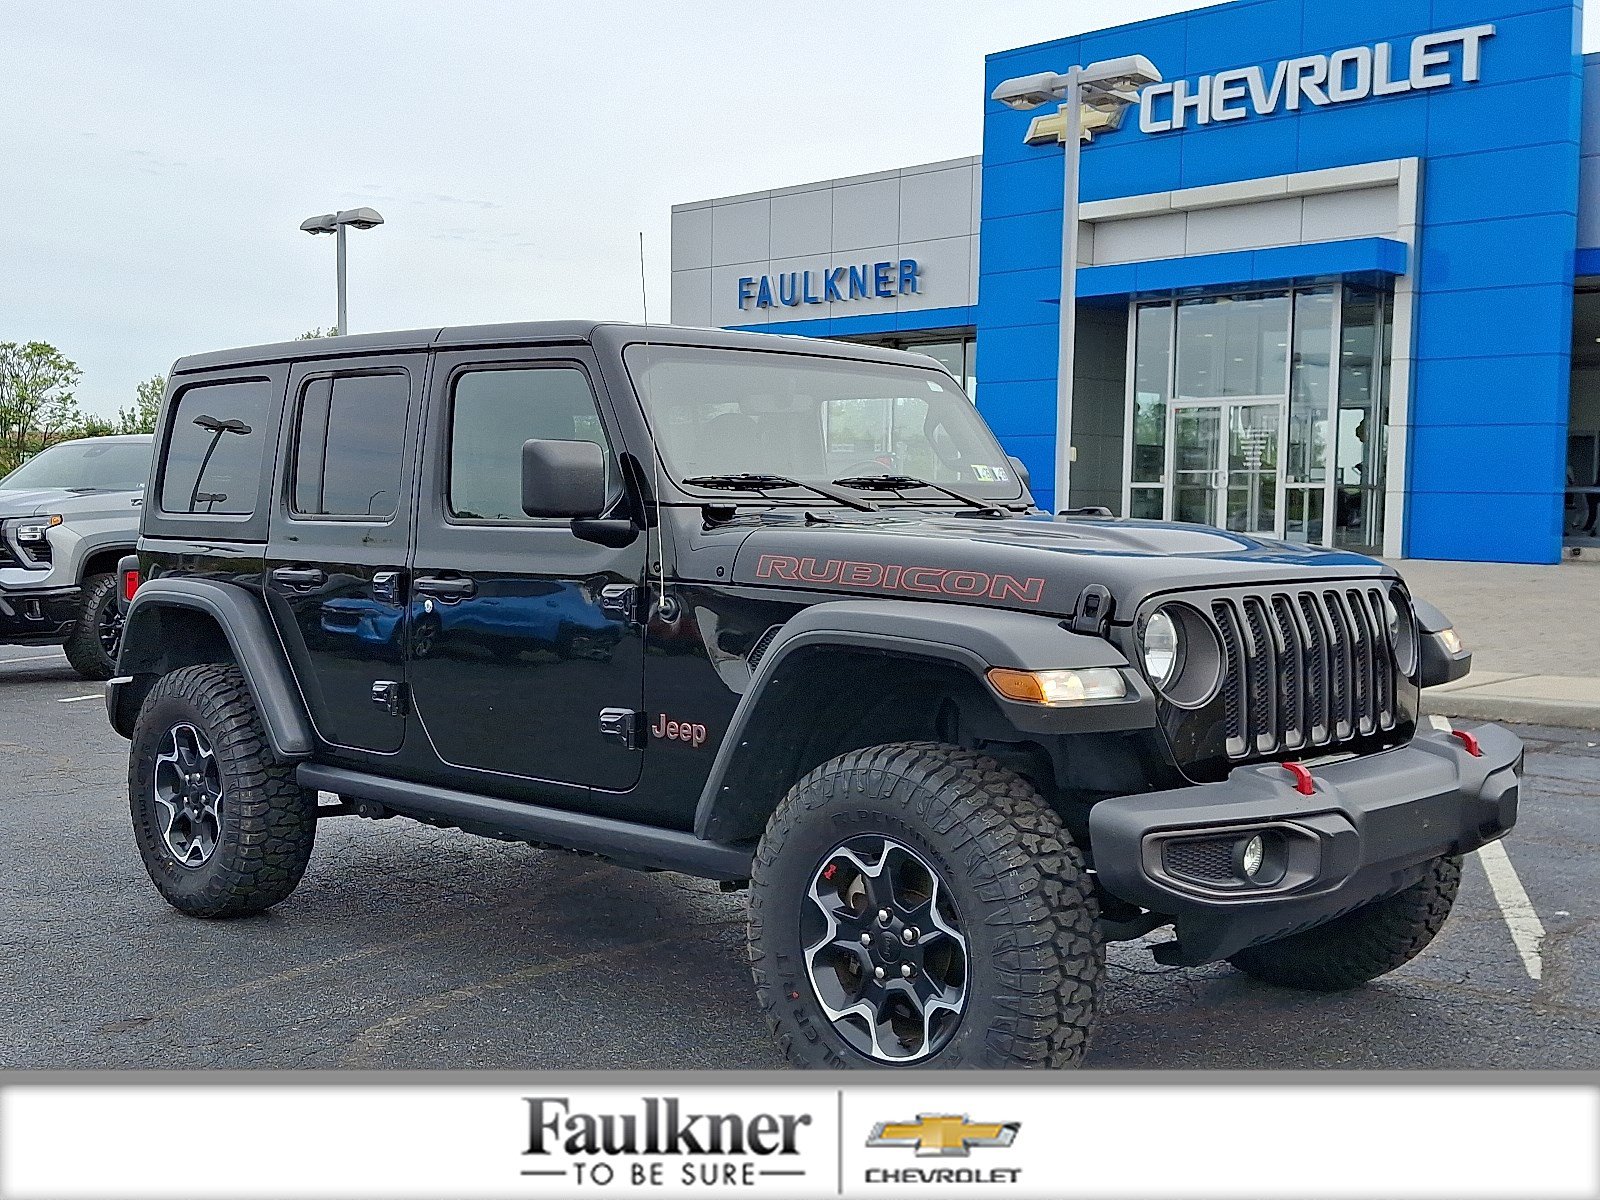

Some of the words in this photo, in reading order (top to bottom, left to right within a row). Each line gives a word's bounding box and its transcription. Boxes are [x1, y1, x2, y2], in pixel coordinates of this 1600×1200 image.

[1138, 24, 1495, 133] CHEVROLET
[738, 258, 922, 310] FAULKNER
[756, 554, 1045, 603] RUBICON
[651, 713, 706, 748] Jeep
